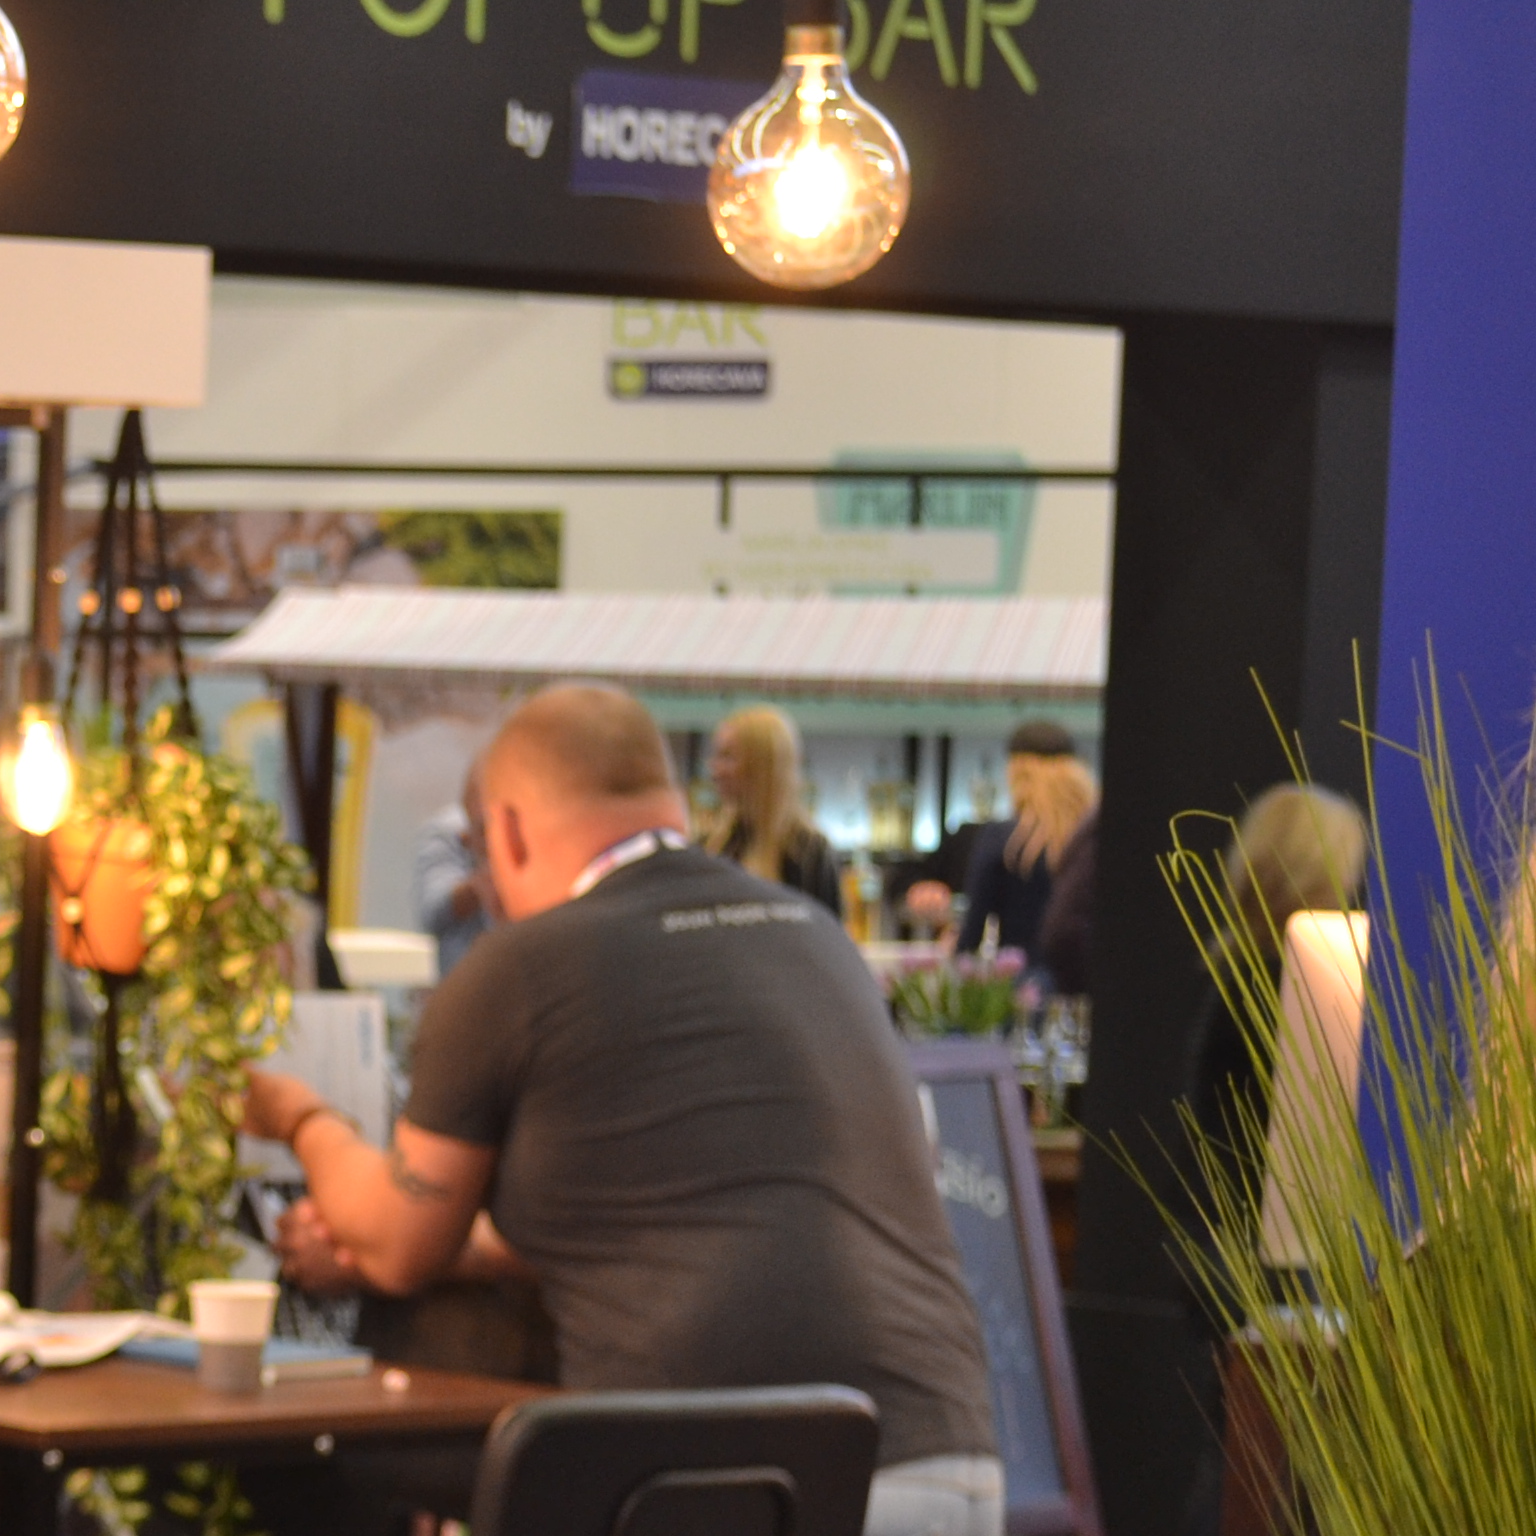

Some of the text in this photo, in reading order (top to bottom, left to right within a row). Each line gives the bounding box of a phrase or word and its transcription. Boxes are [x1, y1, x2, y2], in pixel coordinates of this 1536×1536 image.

[842, 0, 1038, 95] AR
[505, 98, 730, 167] by HOREC
